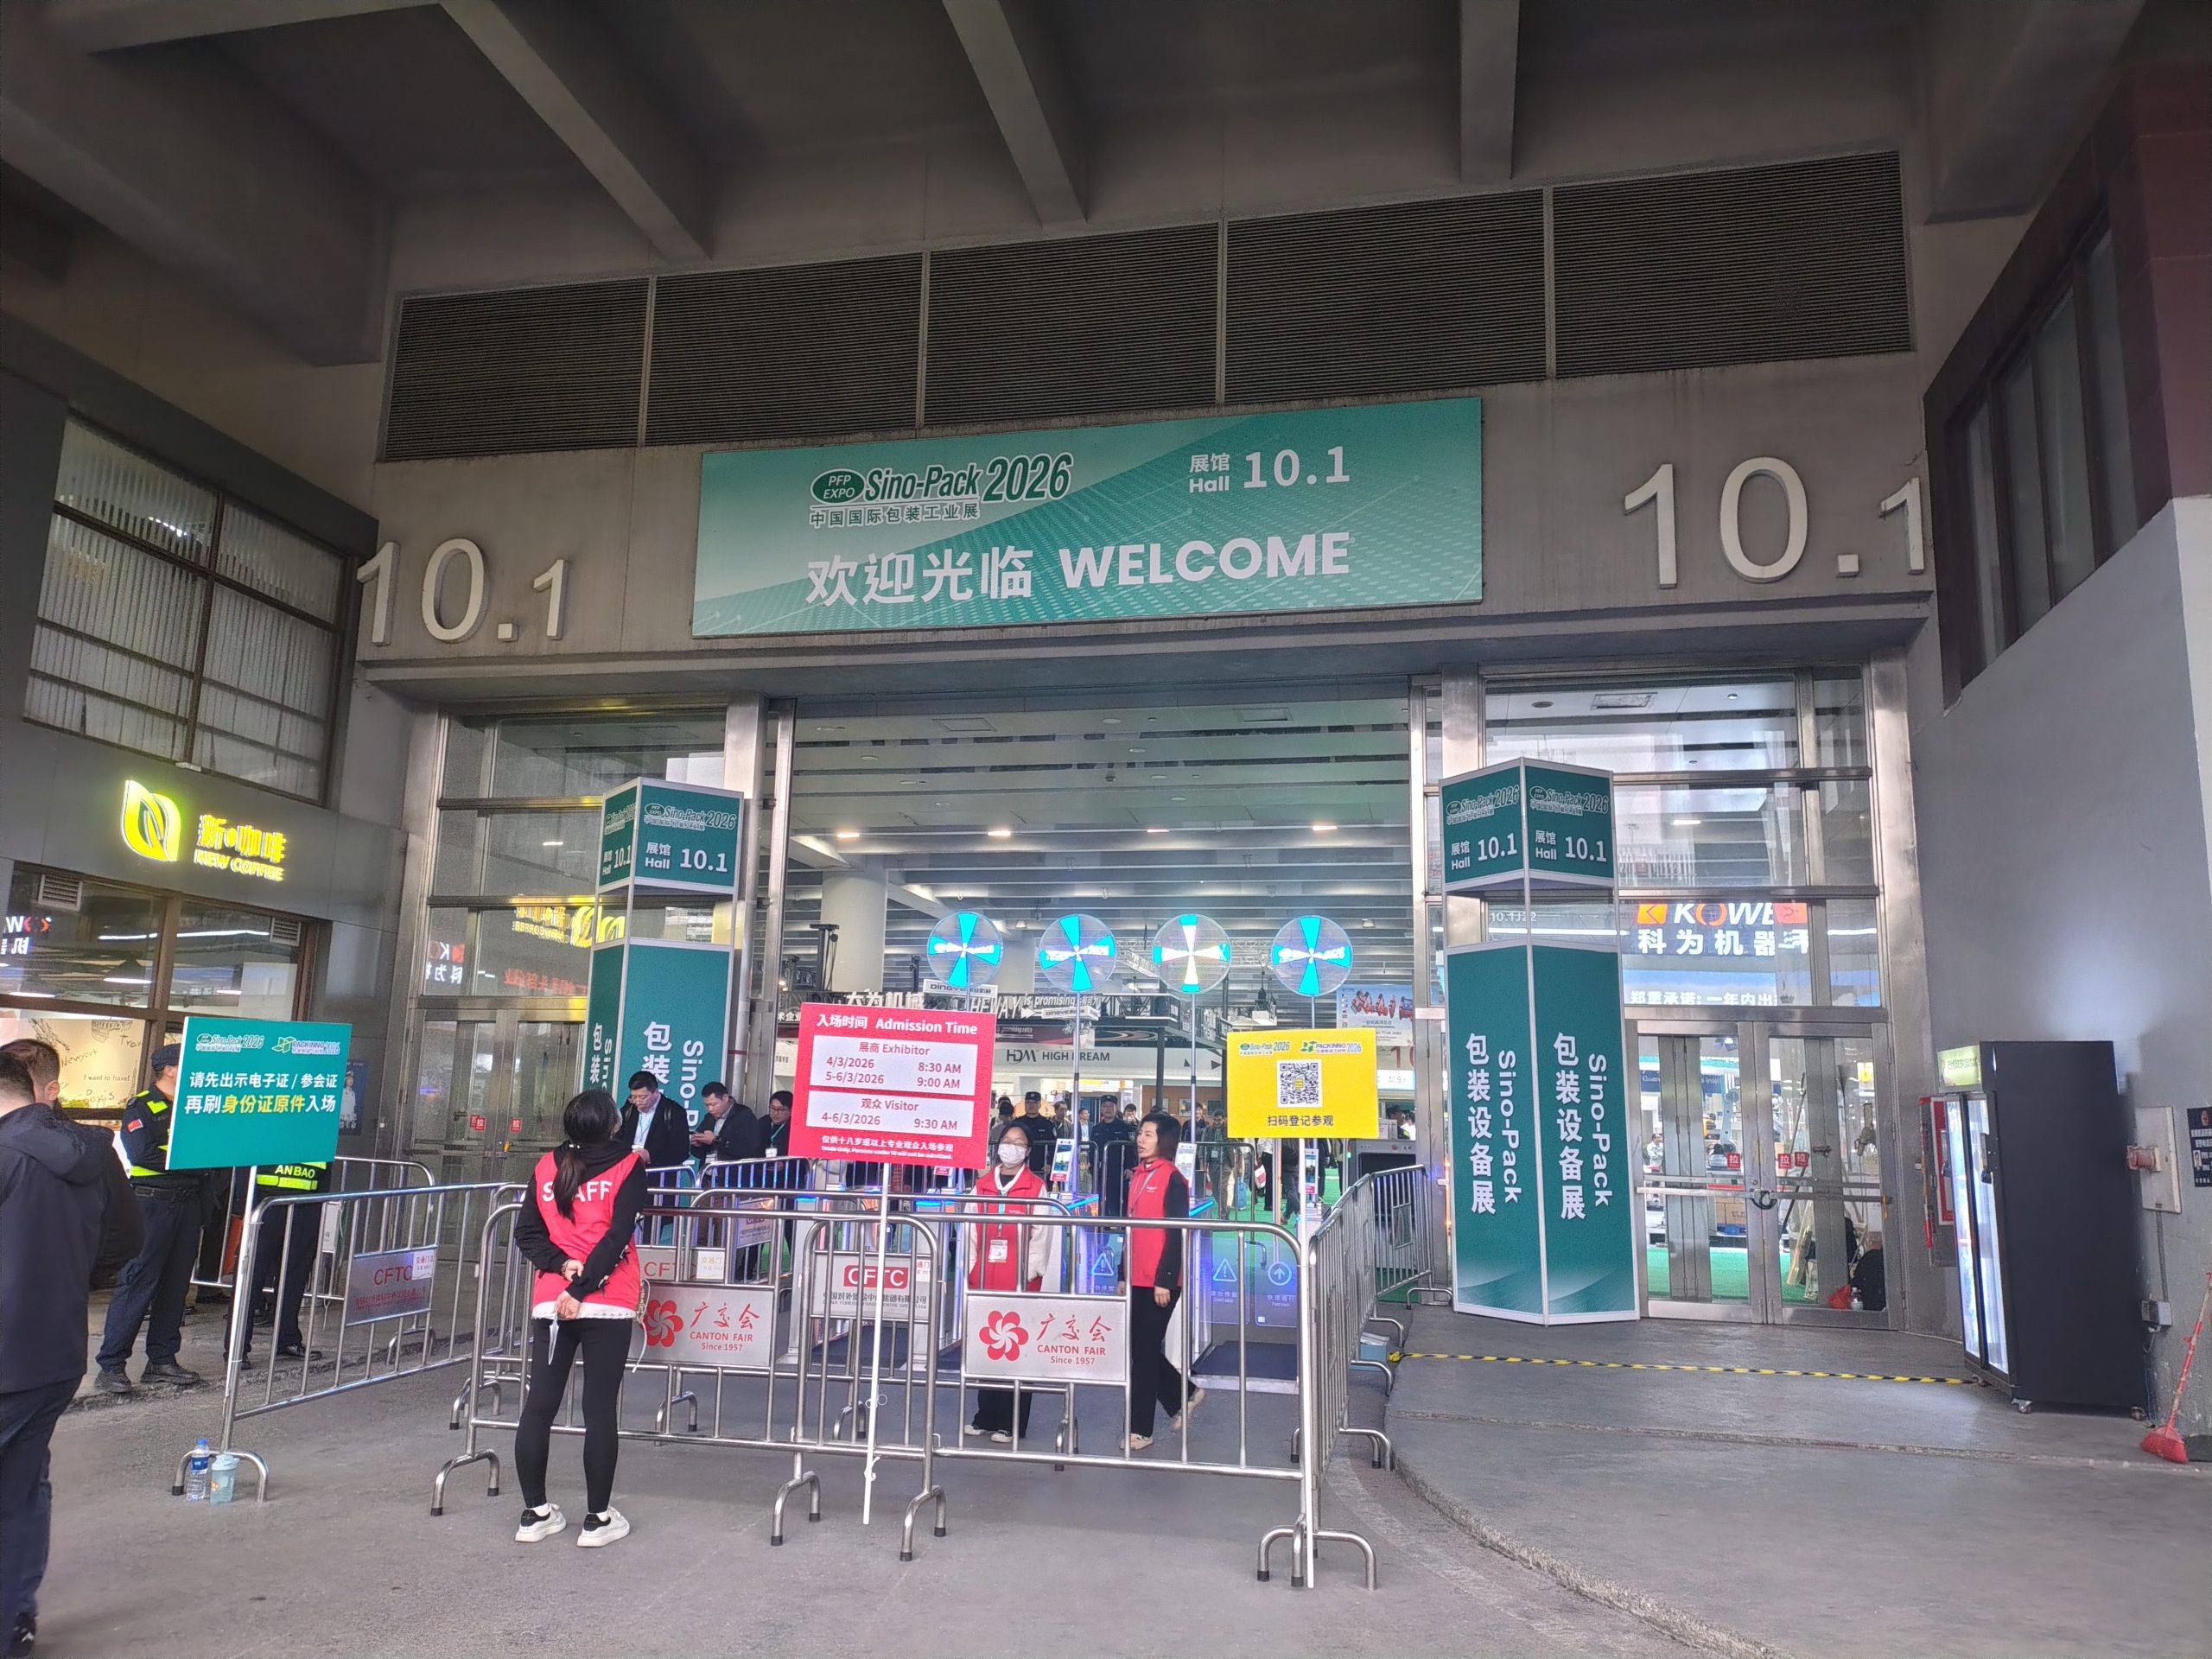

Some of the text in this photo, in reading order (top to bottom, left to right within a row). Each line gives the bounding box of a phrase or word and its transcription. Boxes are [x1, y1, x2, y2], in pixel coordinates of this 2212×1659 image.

[1189, 454, 1230, 474] 展馆
[1243, 445, 1351, 489] 10.1
[828, 474, 851, 486] PFP
[864, 452, 1074, 503] Sino-Pack 2026
[1189, 476, 1230, 494] Hall
[823, 486, 855, 499] EXPO
[810, 504, 979, 528] 中国国际包装工业展
[1624, 456, 1925, 589] 10.1
[805, 532, 1351, 607] 欢迎光临 WELCOME
[357, 537, 570, 646] 10.1
[1461, 785, 1520, 811] Sino-Pack 2026
[1547, 788, 1609, 814] Sino-Pack 2026
[664, 806, 736, 830] Sino-Pack 2026
[1478, 832, 1517, 861] 10.1
[1535, 830, 1556, 845] 展馆
[613, 844, 631, 869] 10.1
[646, 842, 671, 855] 展馆
[1452, 840, 1471, 856] 展馆
[1535, 847, 1557, 861] Hall
[1565, 836, 1607, 862] 10.1
[194, 849, 285, 881] NEW COFFEE
[645, 857, 670, 869] Hall
[680, 849, 728, 873] 10.1
[1452, 857, 1471, 871] Hall
[817, 1014, 978, 1035] 入场时间 Admission Time
[242, 1034, 264, 1048] 2026
[858, 1041, 931, 1056] 展商 Exhibitor
[1273, 1041, 1290, 1052] 2026
[1346, 1044, 1362, 1052] 2026
[826, 1056, 962, 1074] 4/3/2026 8:30 AM
[1042, 1052, 1069, 1061] HIGH
[190, 1072, 289, 1089] 请先出示电子证
[301, 1073, 338, 1089] 参会证
[825, 1071, 960, 1089] 5-6/3/2026 9:00 AM
[185, 1094, 336, 1114] 再刷身份证原件入场
[861, 1098, 919, 1112] 观众 Visitor
[822, 1112, 958, 1130] 4-6/3/2026 9:30 AM
[1268, 1115, 1334, 1127] 扫码登记参观
[1465, 1033, 1497, 1215] 包装设备展
[1498, 1050, 1522, 1204] Sino-Pack
[1554, 1032, 1586, 1220] 包装设备展
[1588, 1053, 1613, 1207] Sino-Pack
[275, 1165, 315, 1179] ANBAO
[543, 1180, 613, 1202] SAFF
[690, 1301, 760, 1330] 广交会
[690, 1332, 753, 1342] CANTON FAIR
[1037, 1313, 1112, 1342] 广交会
[1037, 1344, 1106, 1356] CANTON FAIR
[1050, 1356, 1095, 1365] Since 1957
